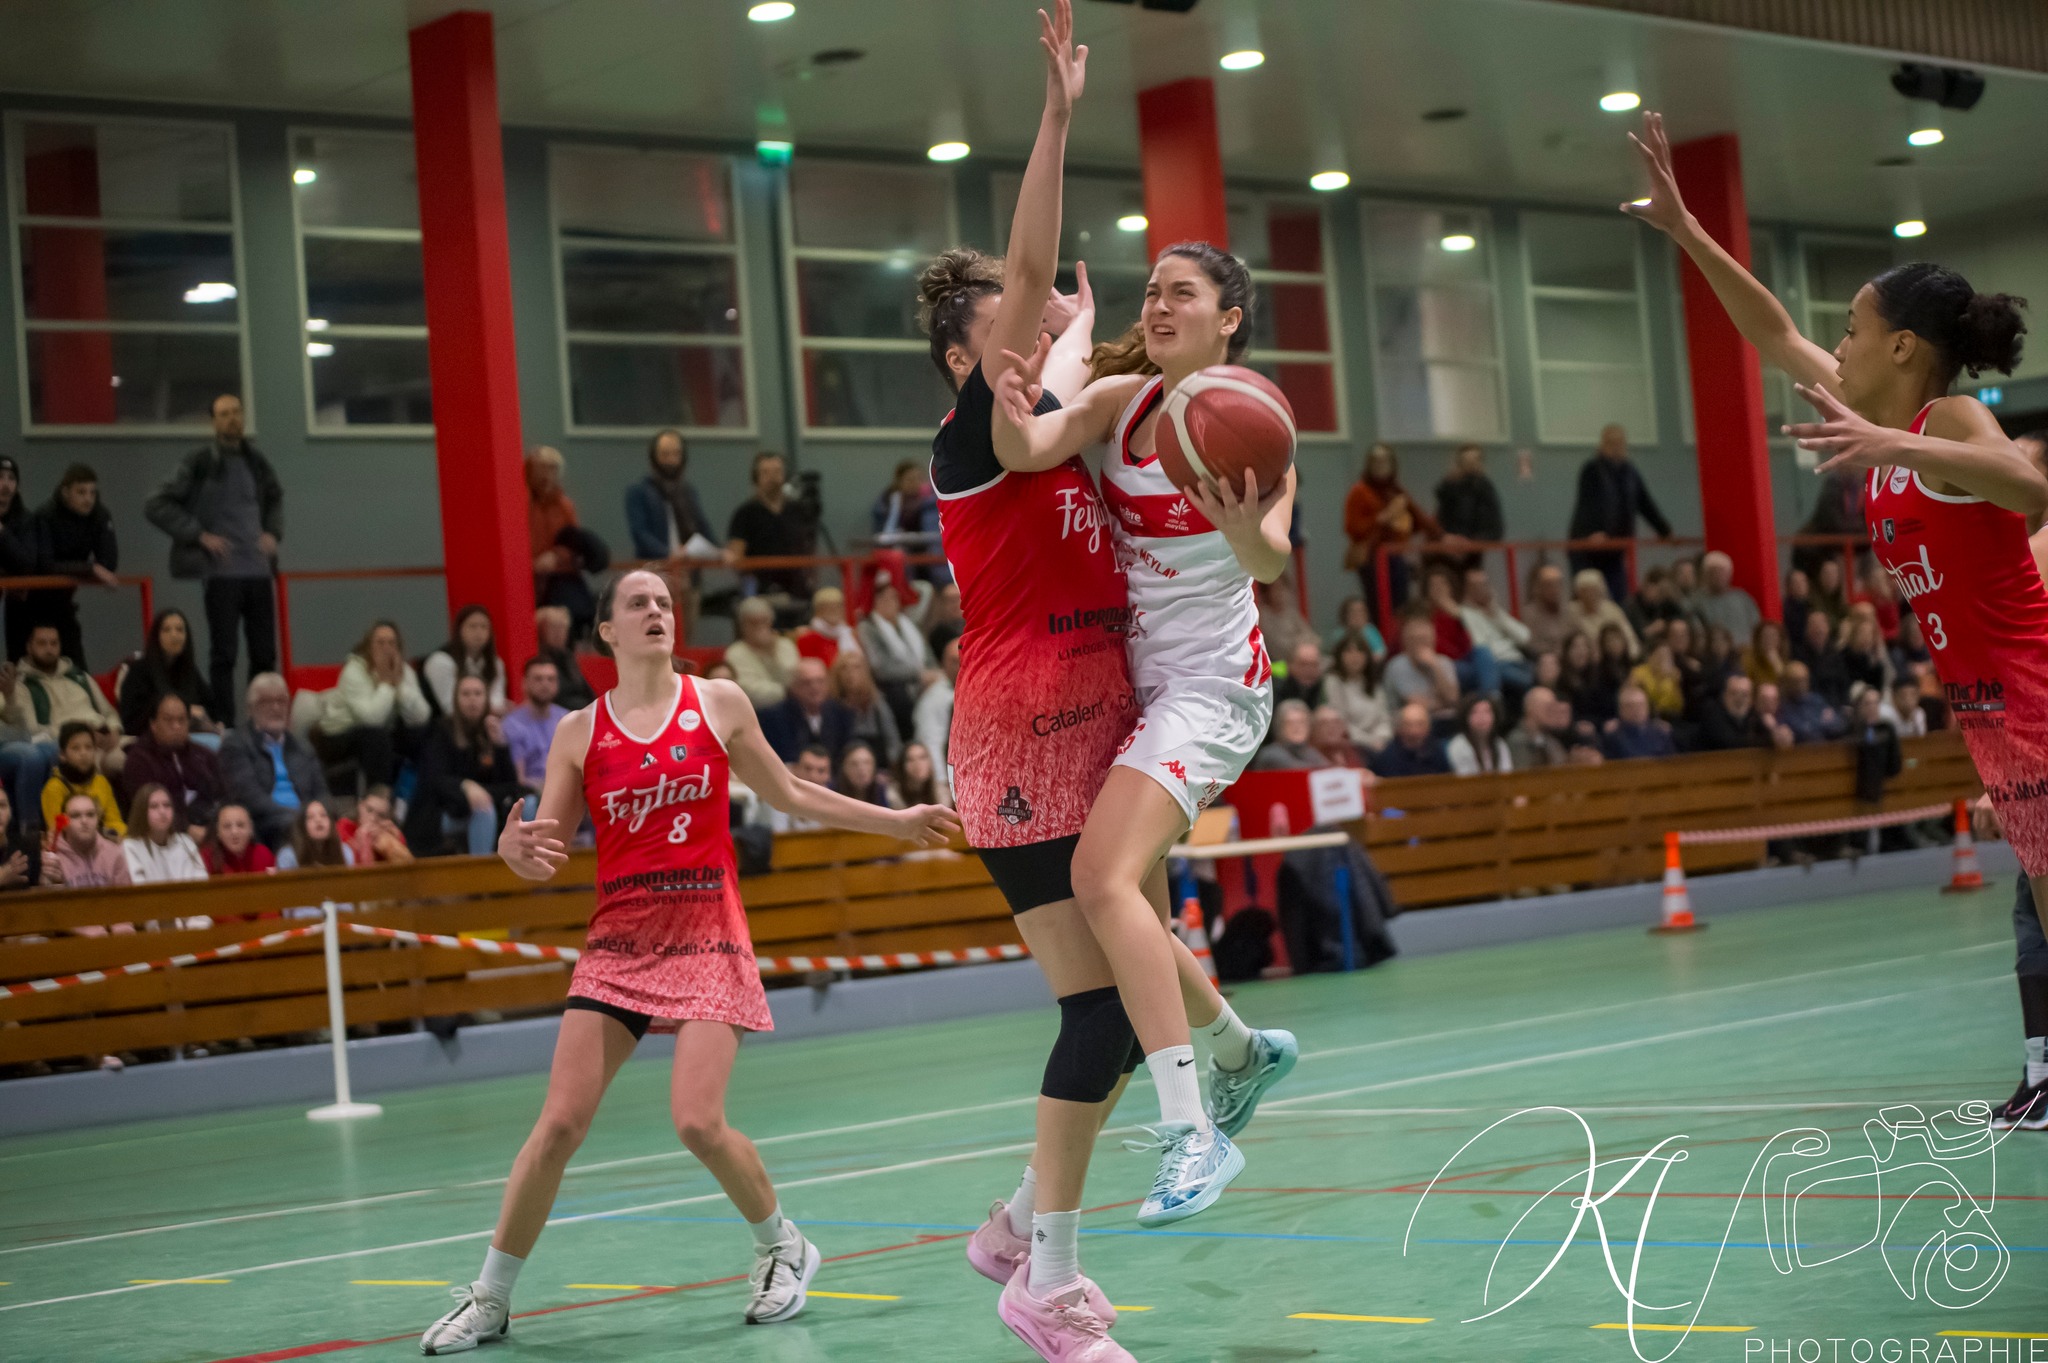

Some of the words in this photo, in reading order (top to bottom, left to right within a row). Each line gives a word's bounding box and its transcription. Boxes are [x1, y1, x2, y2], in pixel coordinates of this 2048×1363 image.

[1031, 702, 1107, 737] Catalent
[600, 763, 714, 834] Feytial
[667, 812, 693, 845] 8
[662, 882, 714, 891] HYPER
